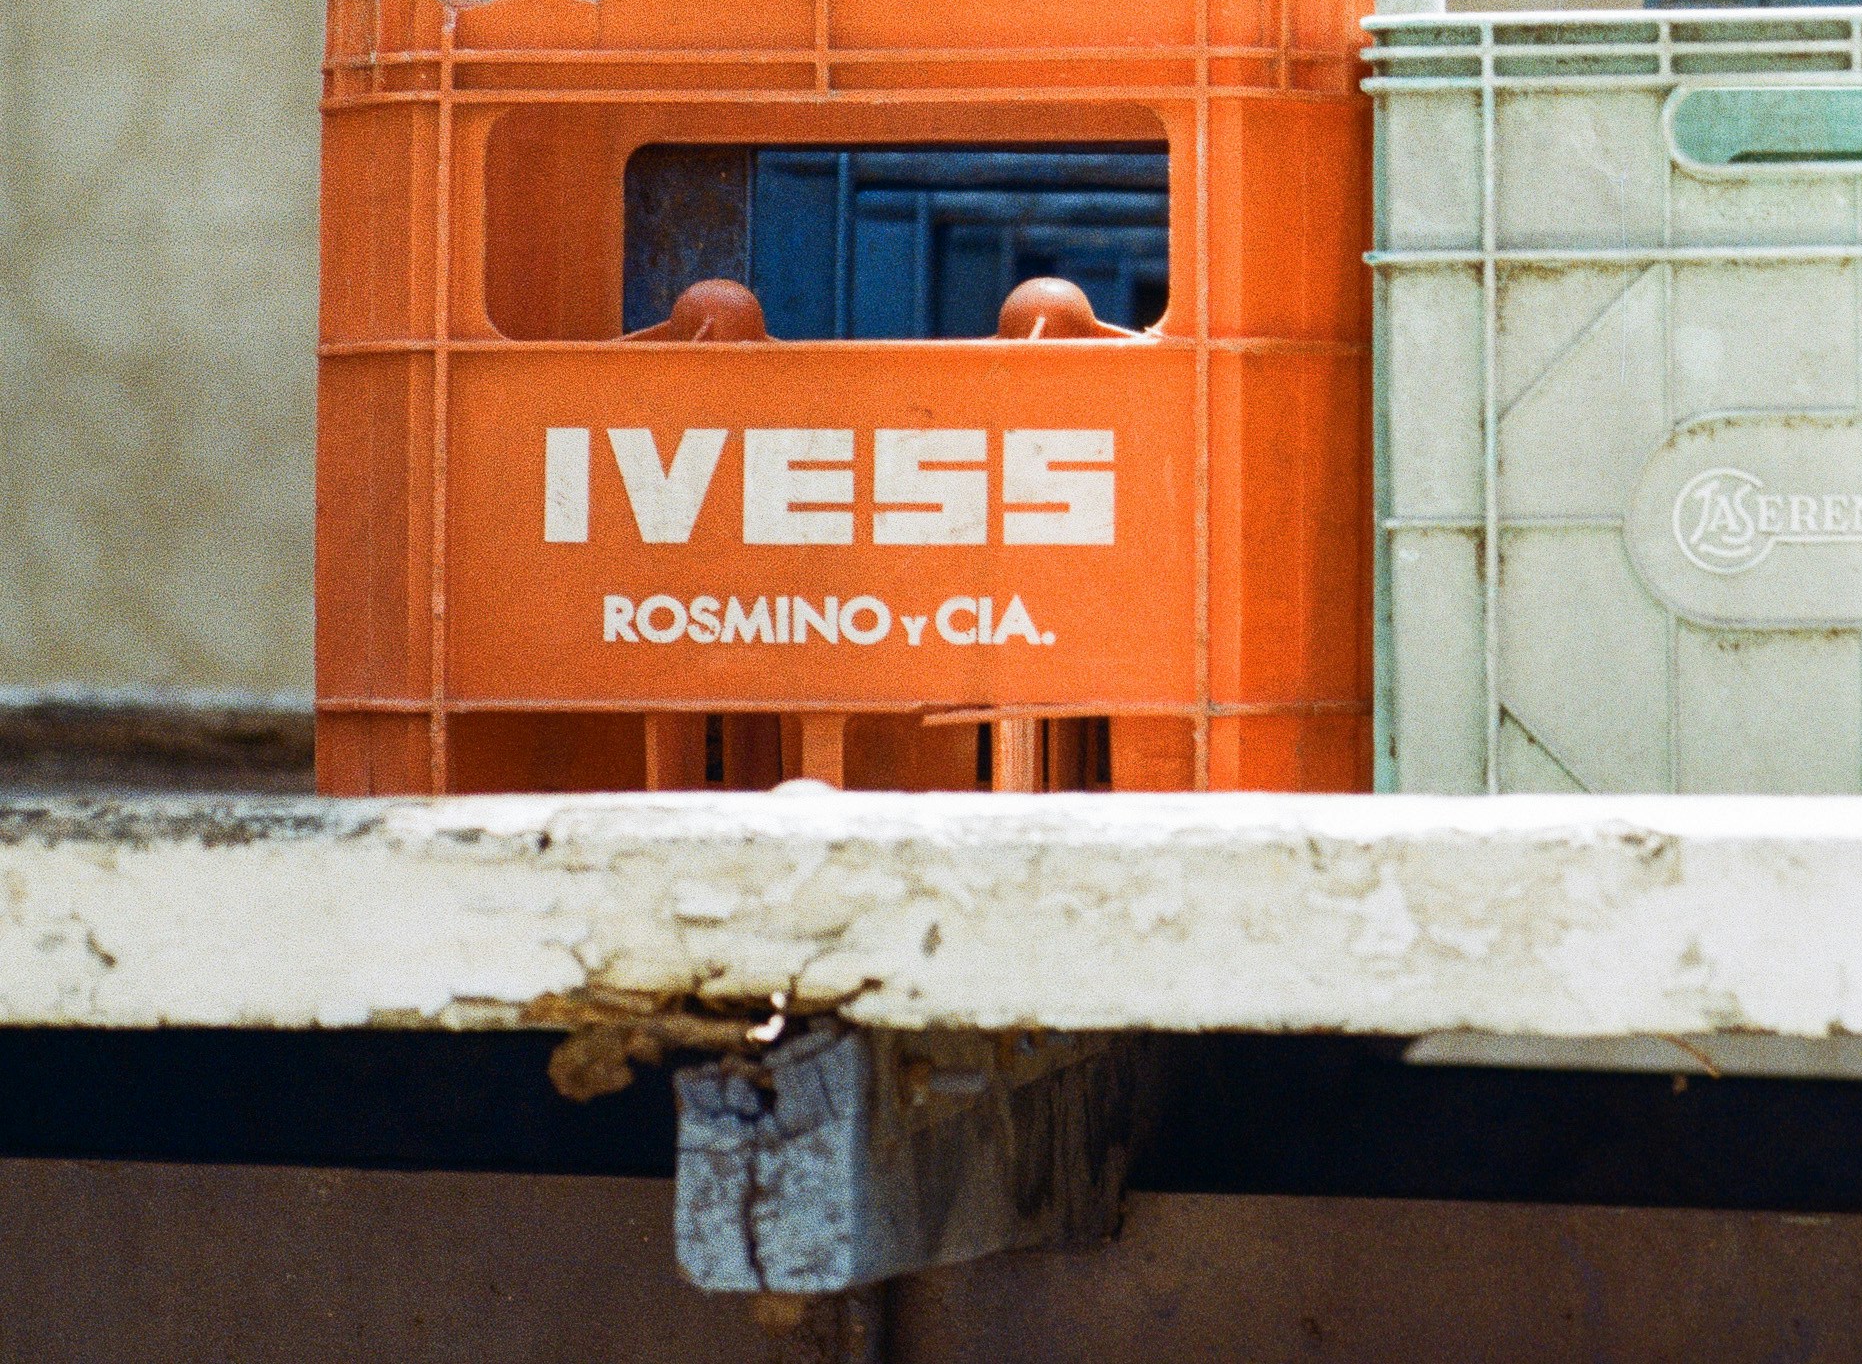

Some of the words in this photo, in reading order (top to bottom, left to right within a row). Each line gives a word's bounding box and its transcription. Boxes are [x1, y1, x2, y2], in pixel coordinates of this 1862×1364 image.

[544, 428, 1116, 544] IVESS
[602, 596, 890, 645] ROSMINO
[936, 596, 1057, 646] CIA.
